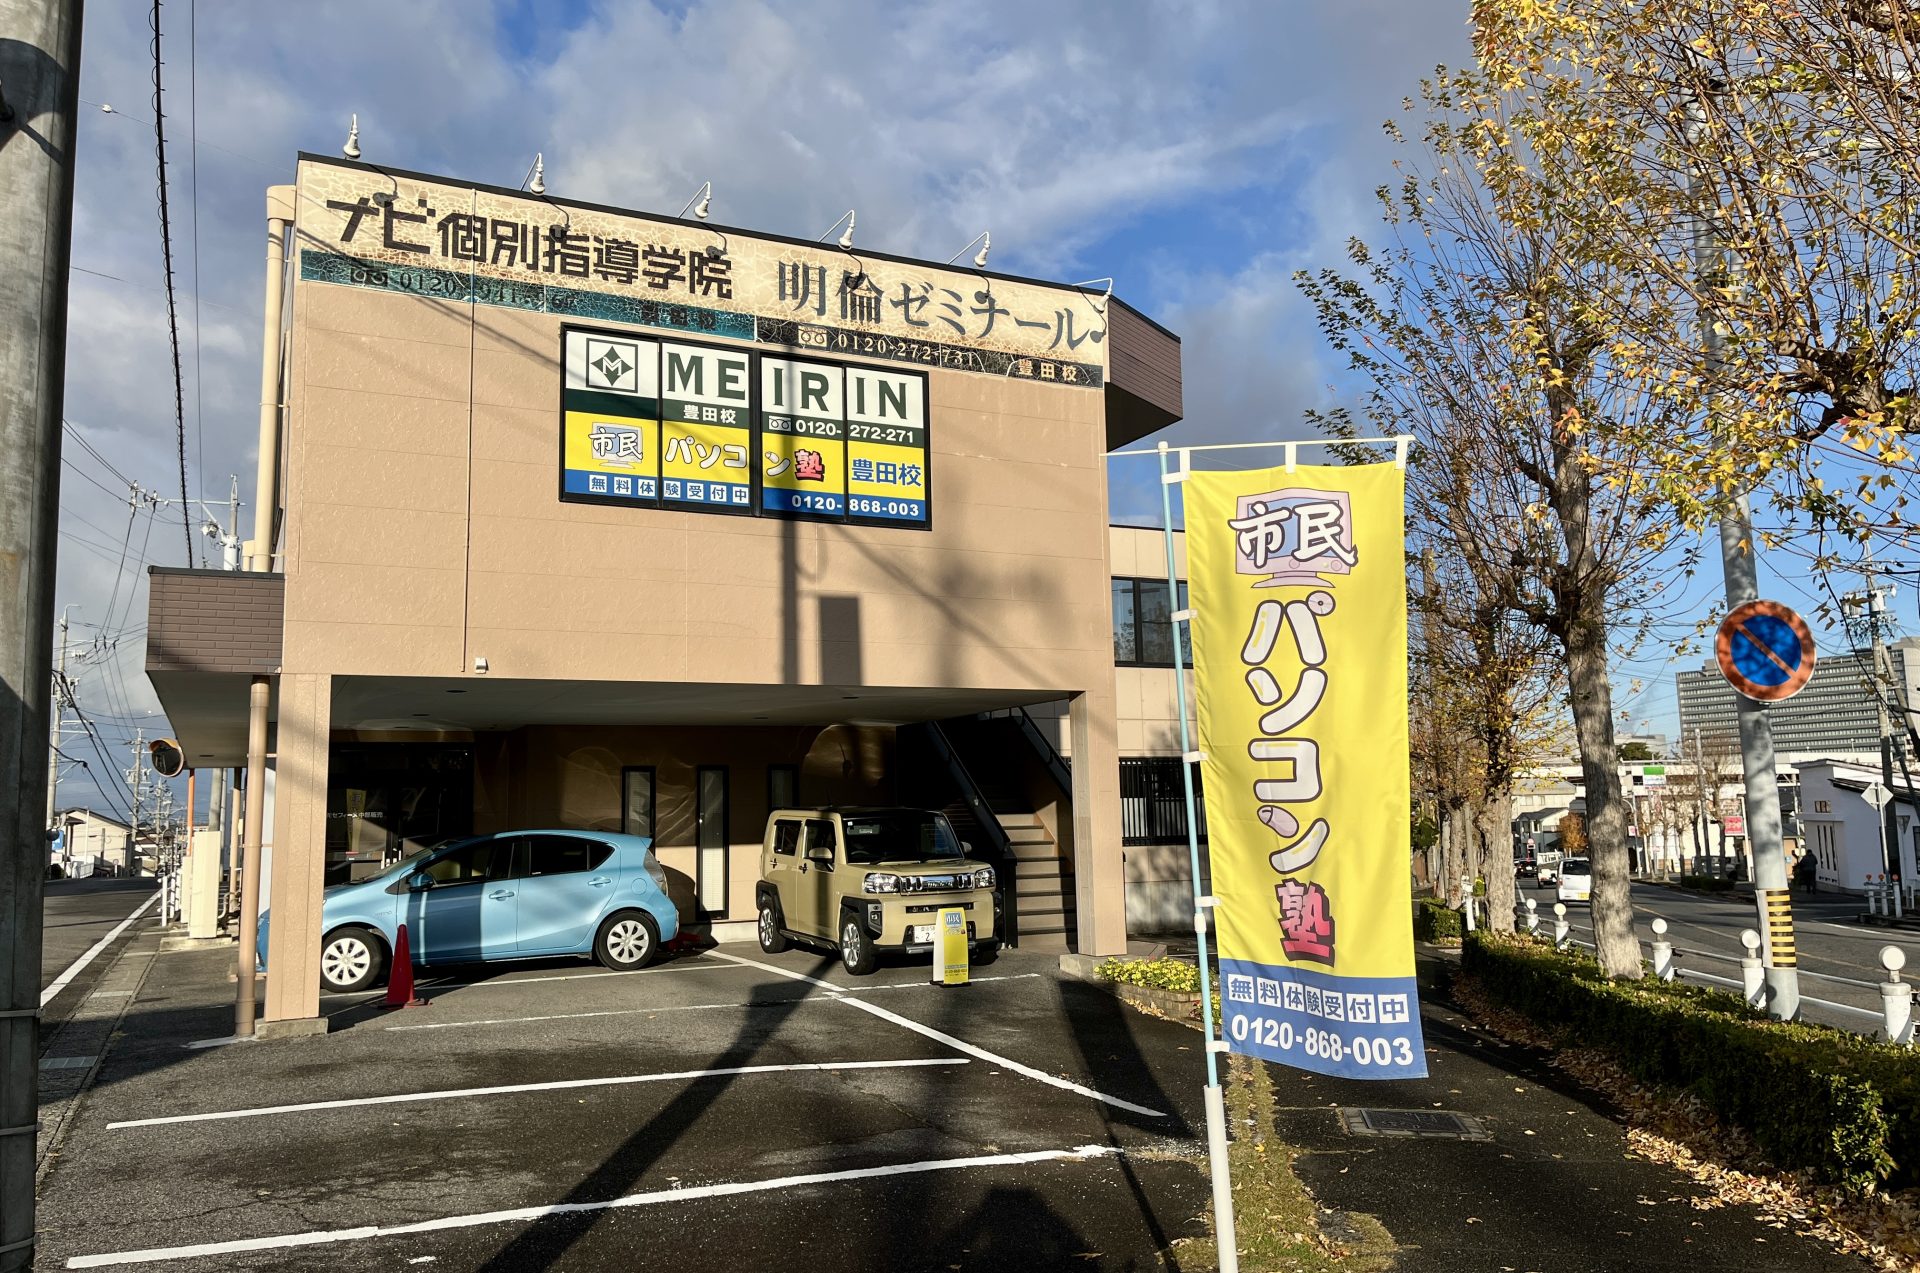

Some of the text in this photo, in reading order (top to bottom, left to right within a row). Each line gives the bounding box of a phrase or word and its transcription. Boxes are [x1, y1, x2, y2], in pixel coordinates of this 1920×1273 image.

[326, 197, 732, 299] ナビ個別指導学院
[778, 260, 1090, 351] 明倫ゼミナール
[838, 333, 973, 366] 0120-272-731
[666, 352, 907, 420] MEIRIN
[683, 404, 737, 425] 豊田校
[795, 419, 914, 443] 0120-272-271
[590, 475, 749, 502] 無料体験受付中
[851, 458, 922, 488] 豊田校
[792, 494, 920, 517] 0120-868-003
[1227, 500, 1358, 569] 市民
[1240, 590, 1336, 968] パソコン塾
[1229, 976, 1407, 1022] 無料体験受付中
[1231, 1014, 1414, 1066] 0120-868-003
